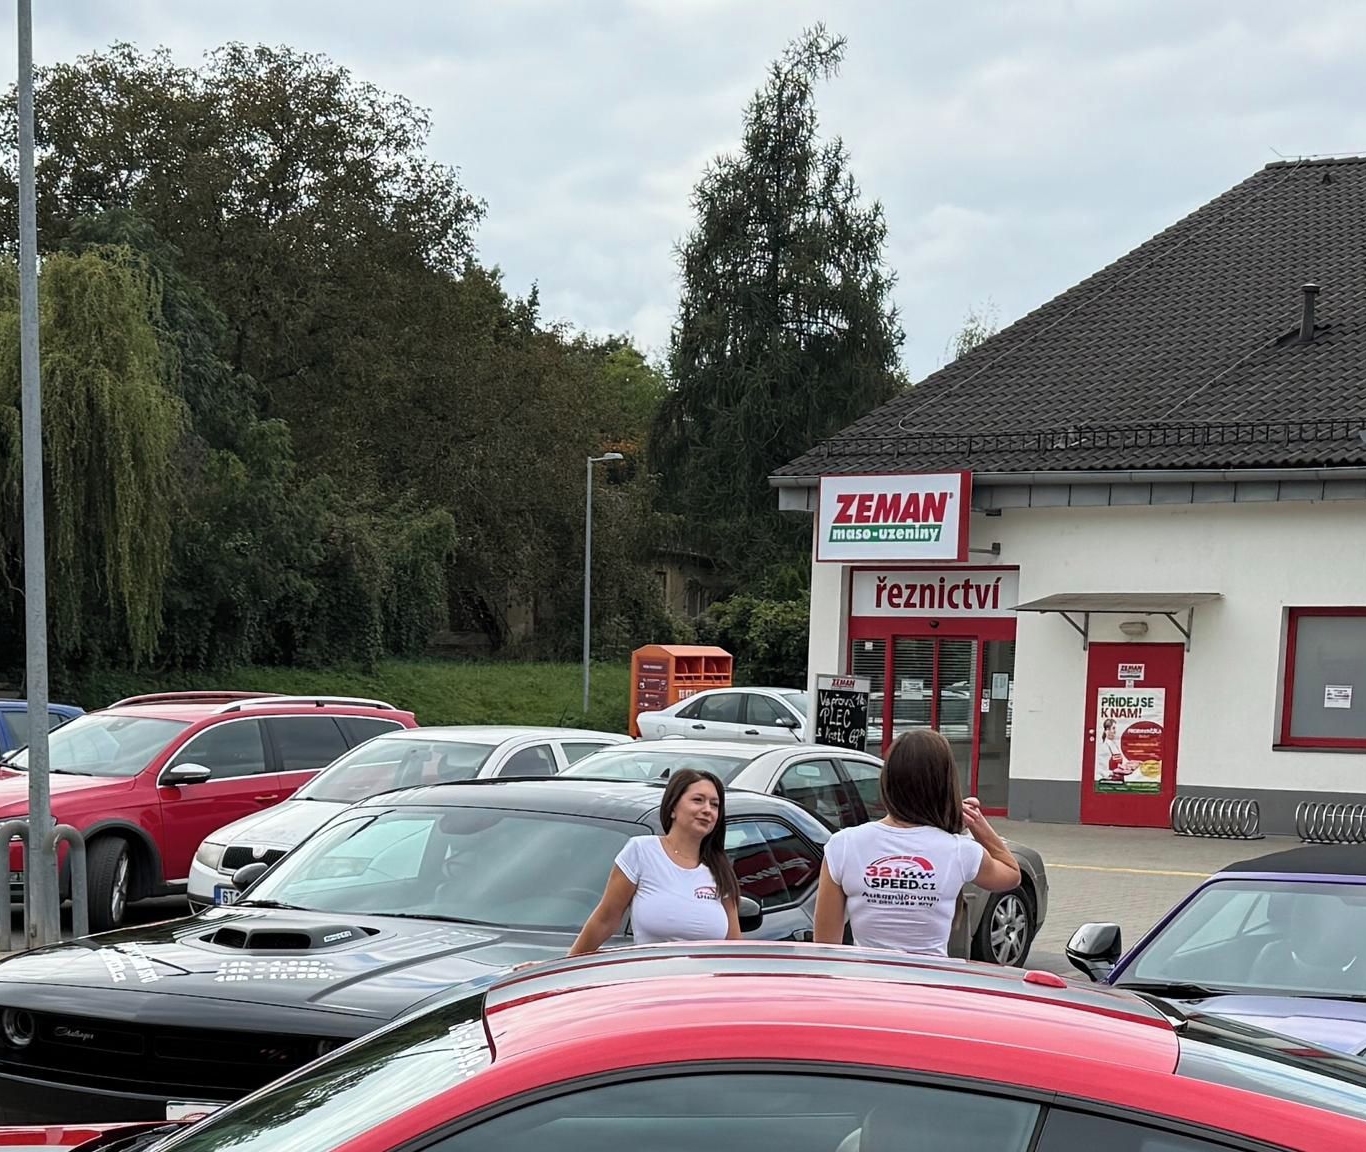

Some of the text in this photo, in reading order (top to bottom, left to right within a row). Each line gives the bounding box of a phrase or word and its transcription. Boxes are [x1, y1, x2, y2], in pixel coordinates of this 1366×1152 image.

[833, 492, 949, 524] ZEMAN
[832, 525, 940, 542] maso-uzeniny
[875, 576, 1002, 609] řeznictví
[1101, 694, 1154, 707] PŘIDEJ SE
[1101, 708, 1109, 718] K
[871, 878, 936, 890] SPEED.cz
